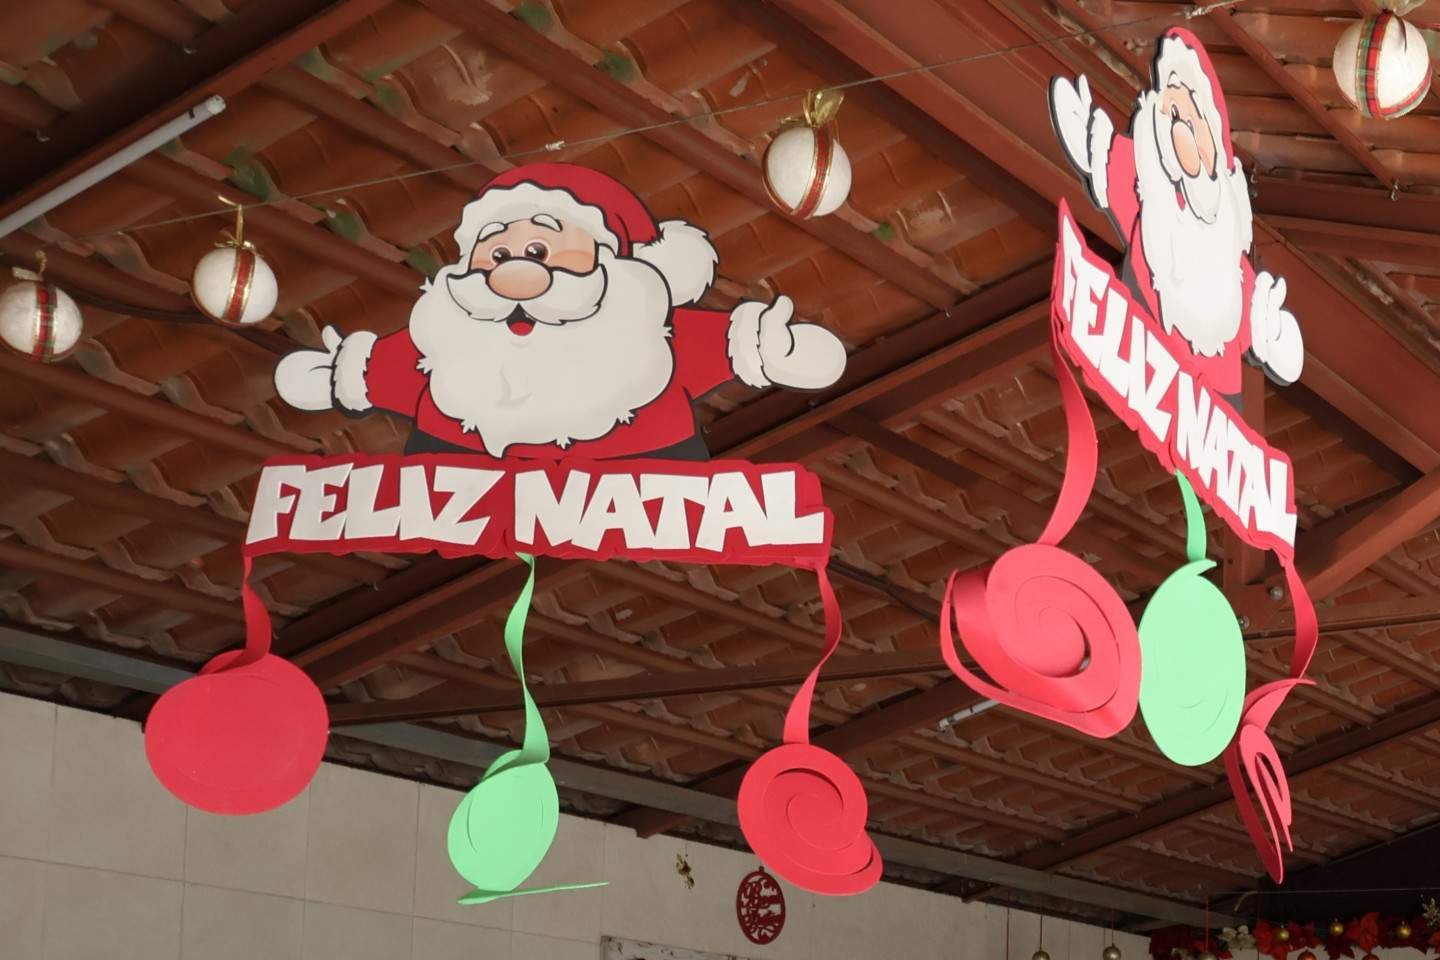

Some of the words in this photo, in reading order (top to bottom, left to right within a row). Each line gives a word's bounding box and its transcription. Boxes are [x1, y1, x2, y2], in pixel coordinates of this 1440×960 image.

[1062, 214, 1180, 443] FELIZ
[1176, 370, 1298, 549] NATAL
[245, 463, 505, 546] FELIZ
[514, 470, 825, 552] NATAL
